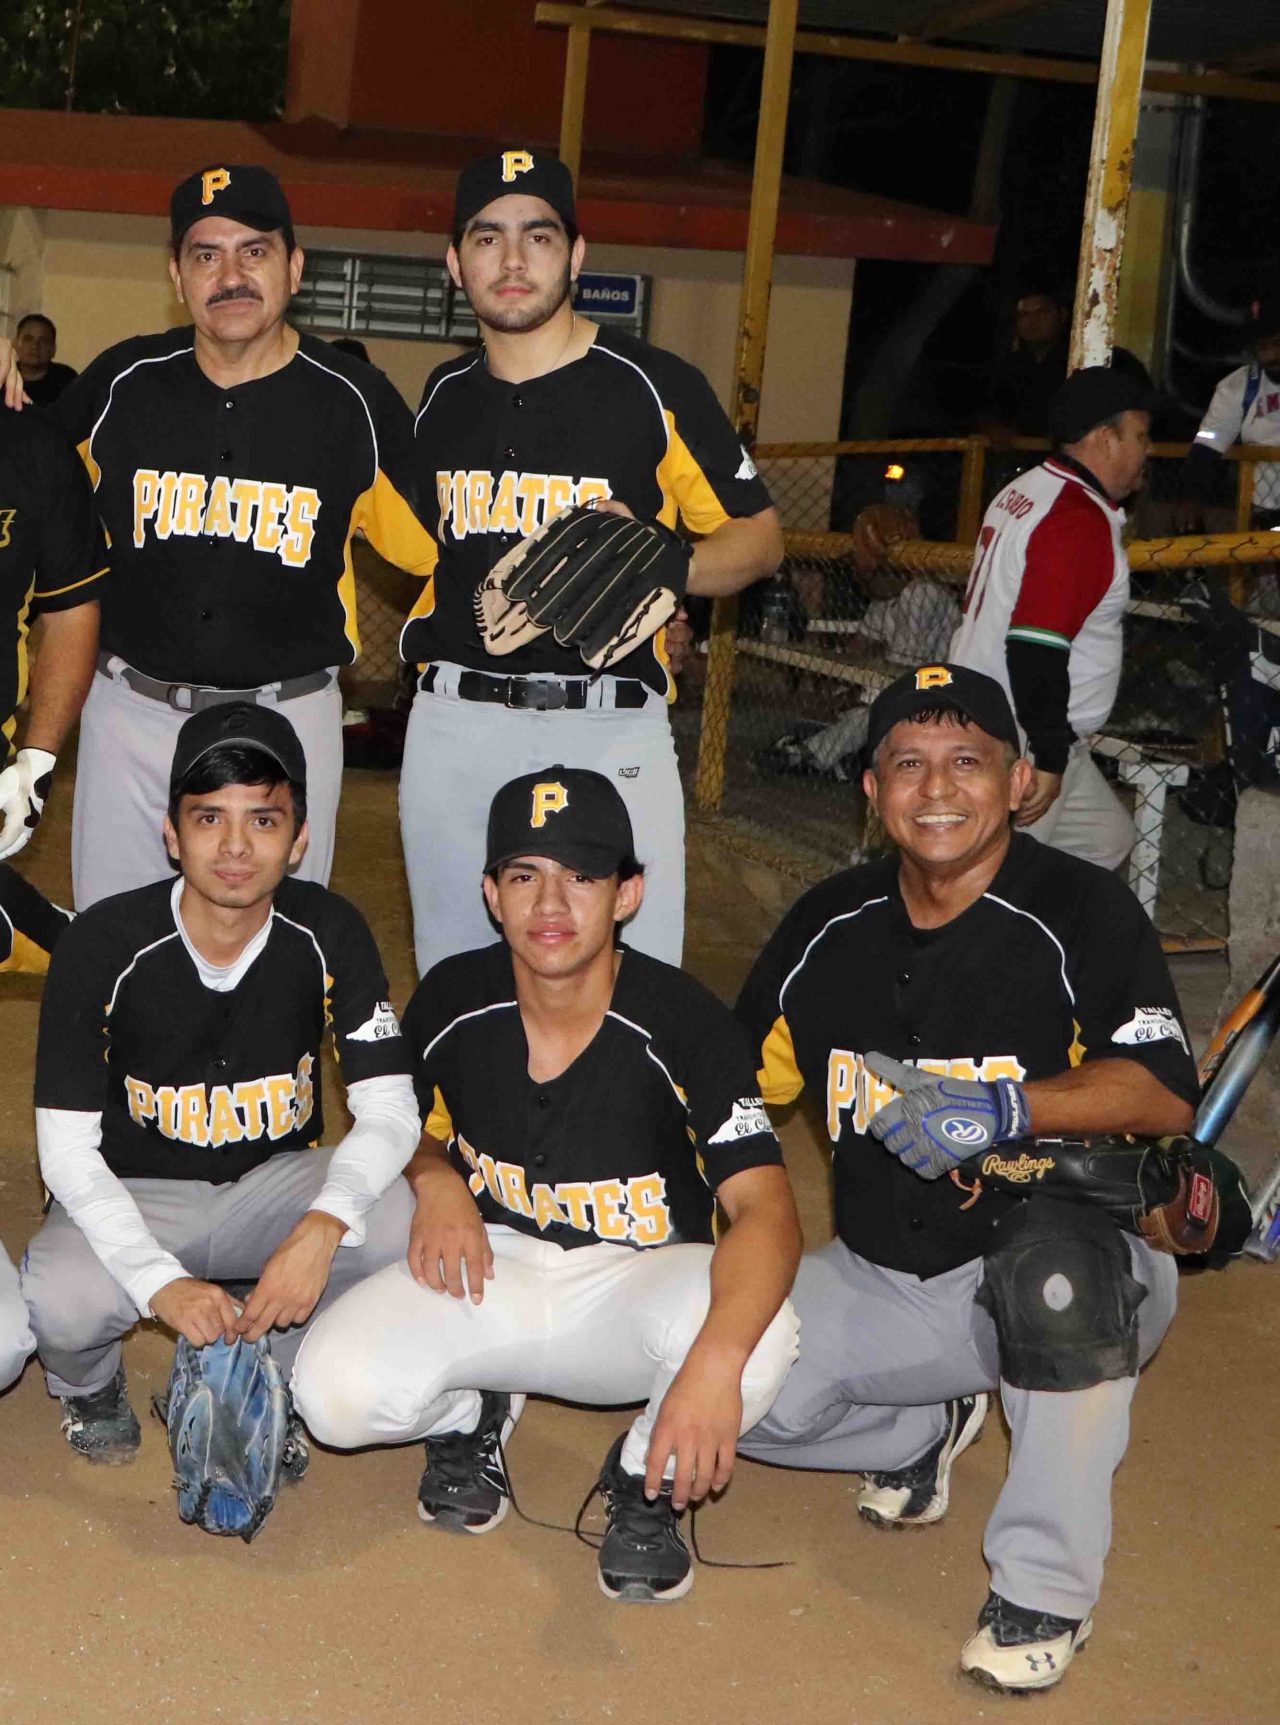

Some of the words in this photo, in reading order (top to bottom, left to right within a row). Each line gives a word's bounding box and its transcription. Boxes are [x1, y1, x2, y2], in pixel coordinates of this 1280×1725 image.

[501, 150, 534, 182] P
[201, 168, 231, 205] P
[582, 288, 630, 301] BAÑOS
[131, 468, 322, 569] PIRATES
[914, 665, 953, 690] P
[530, 782, 569, 828] P
[124, 1052, 316, 1149] PIRATES
[982, 1153, 1056, 1178] Rawlings
